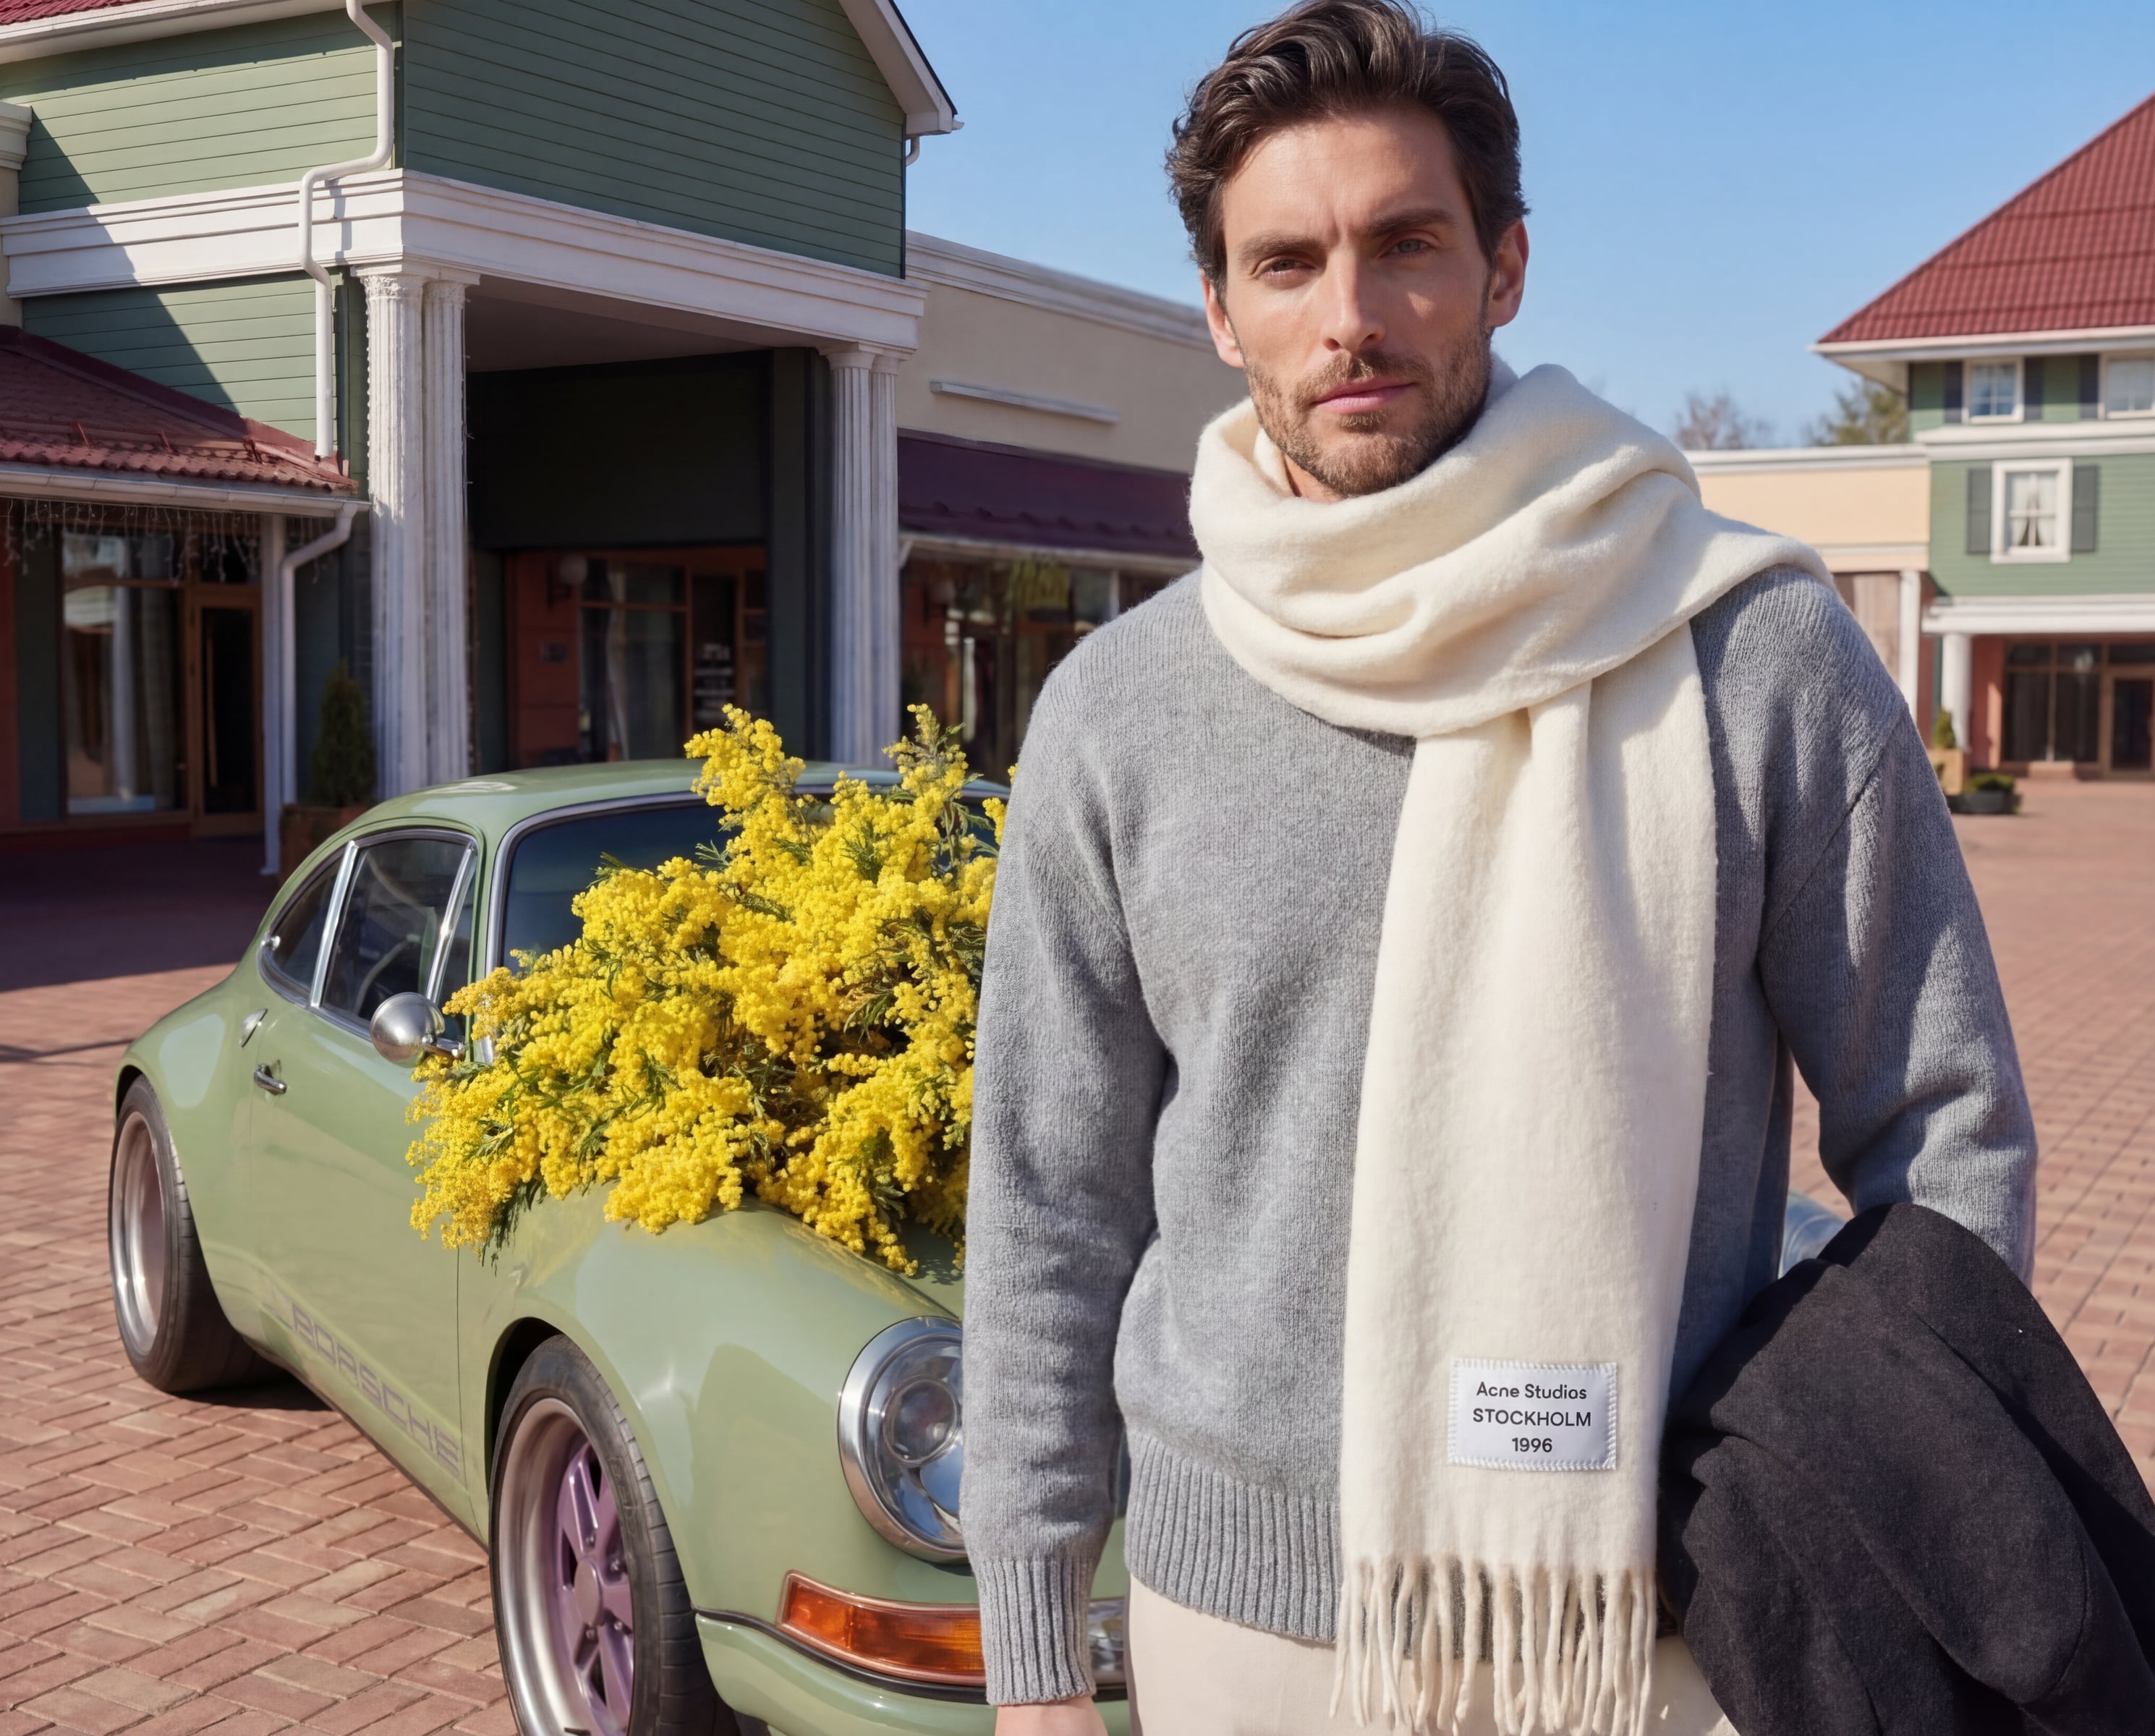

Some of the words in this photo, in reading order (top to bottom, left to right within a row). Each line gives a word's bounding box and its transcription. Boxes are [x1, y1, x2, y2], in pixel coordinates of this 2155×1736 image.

[1476, 1382, 1520, 1397] Acne
[1473, 1408, 1591, 1426] STOCKHOLM
[1512, 1437, 1553, 1453] 1996
